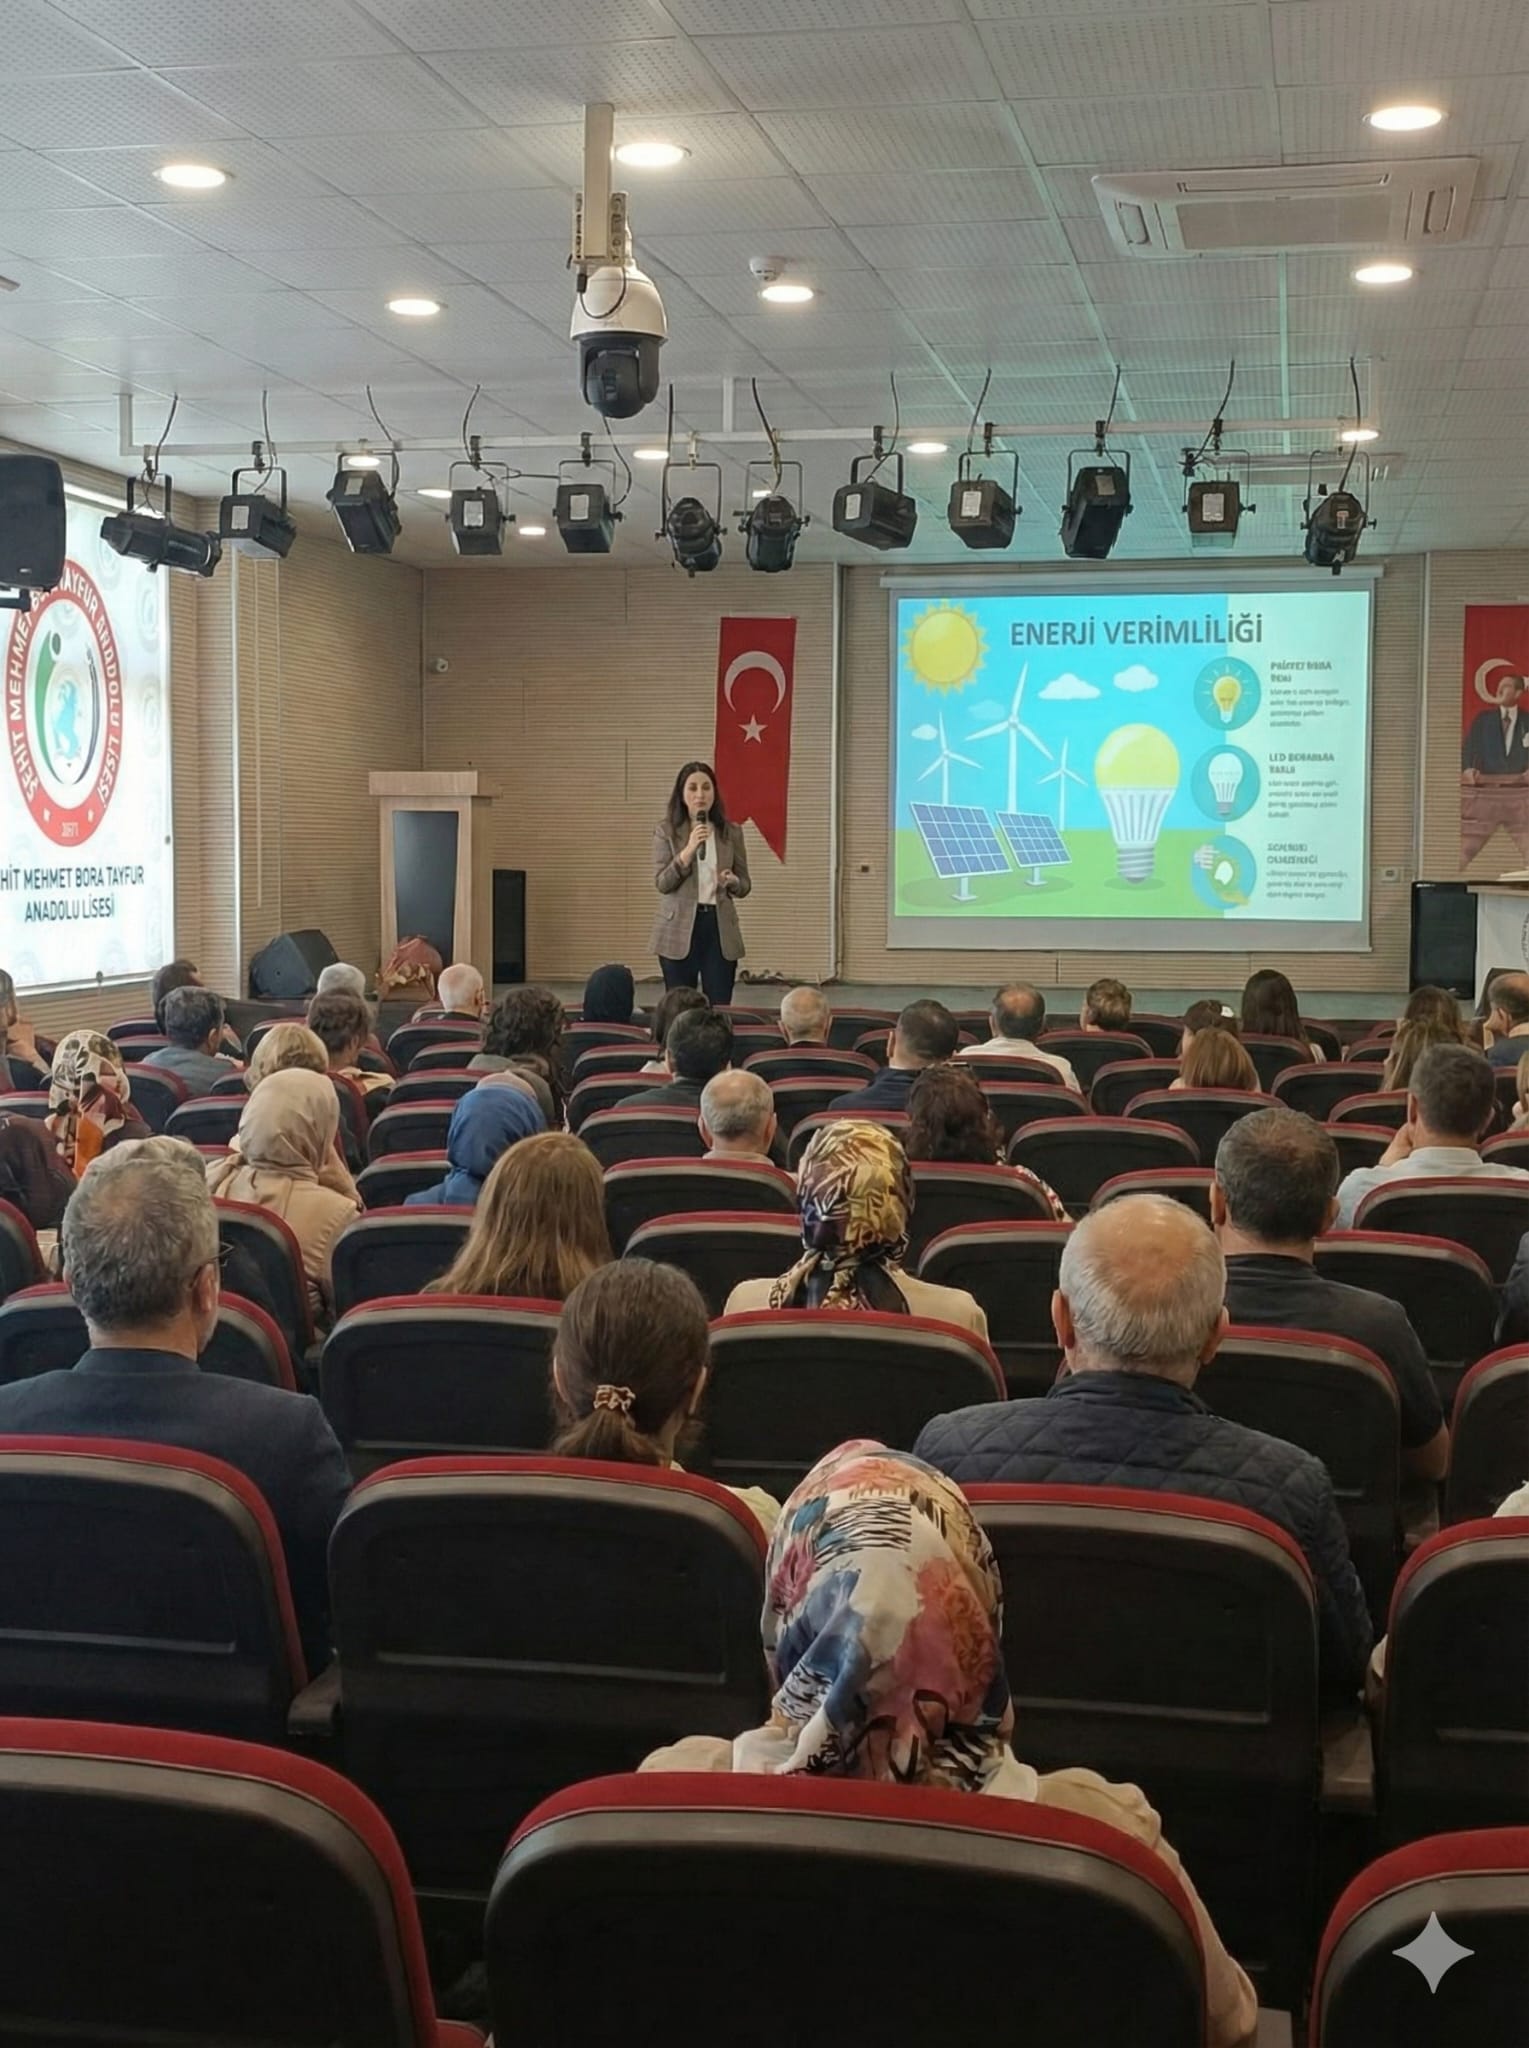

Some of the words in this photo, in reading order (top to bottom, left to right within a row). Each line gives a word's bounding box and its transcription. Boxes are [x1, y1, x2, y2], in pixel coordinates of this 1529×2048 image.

[1011, 616, 1095, 646] ENERJİ
[1103, 613, 1263, 645] VERİMLİLİĞİ
[24, 868, 73, 890] MEHMET
[75, 867, 104, 888] BORA
[107, 865, 144, 886] TAYFUR
[25, 900, 80, 923] ANADOLU
[82, 893, 115, 919] LİSESİ
